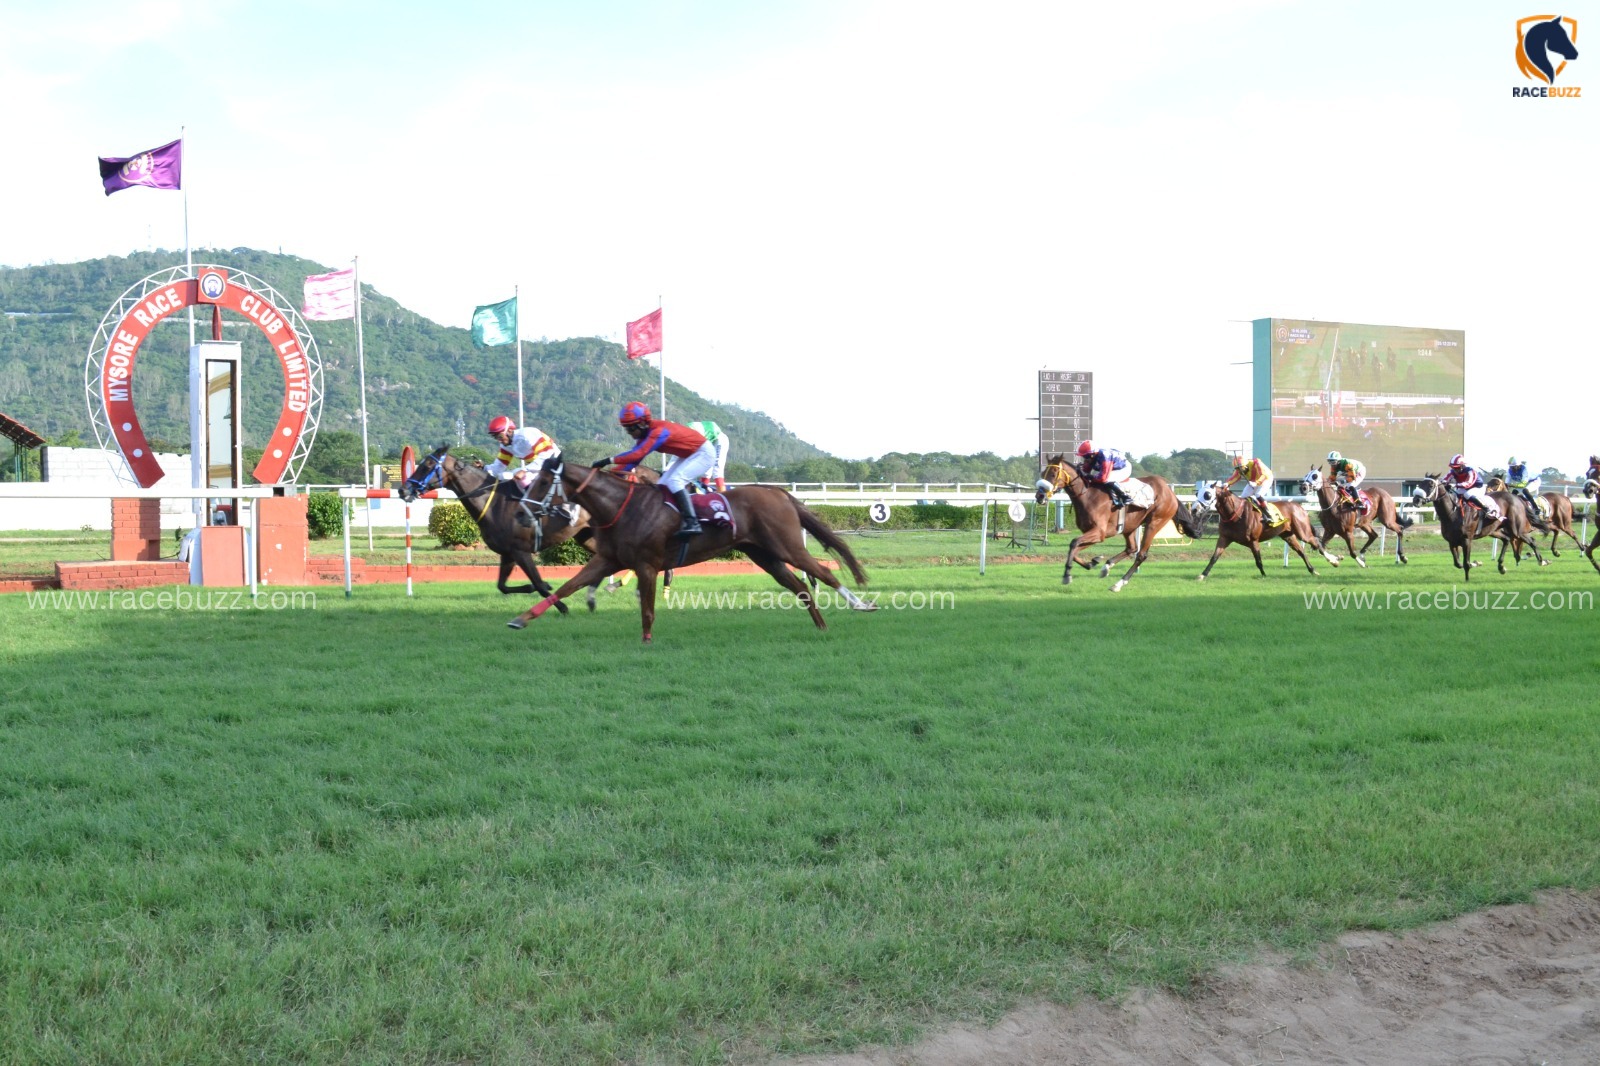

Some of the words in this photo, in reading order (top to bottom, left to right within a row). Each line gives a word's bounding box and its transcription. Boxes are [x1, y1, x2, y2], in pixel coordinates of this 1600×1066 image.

[109, 329, 138, 402] MYSORE
[134, 288, 182, 327] RACE
[240, 295, 283, 335] CLUB
[278, 339, 307, 412] LIMITED
[874, 503, 887, 521] 3
[1012, 506, 1021, 519] 4
